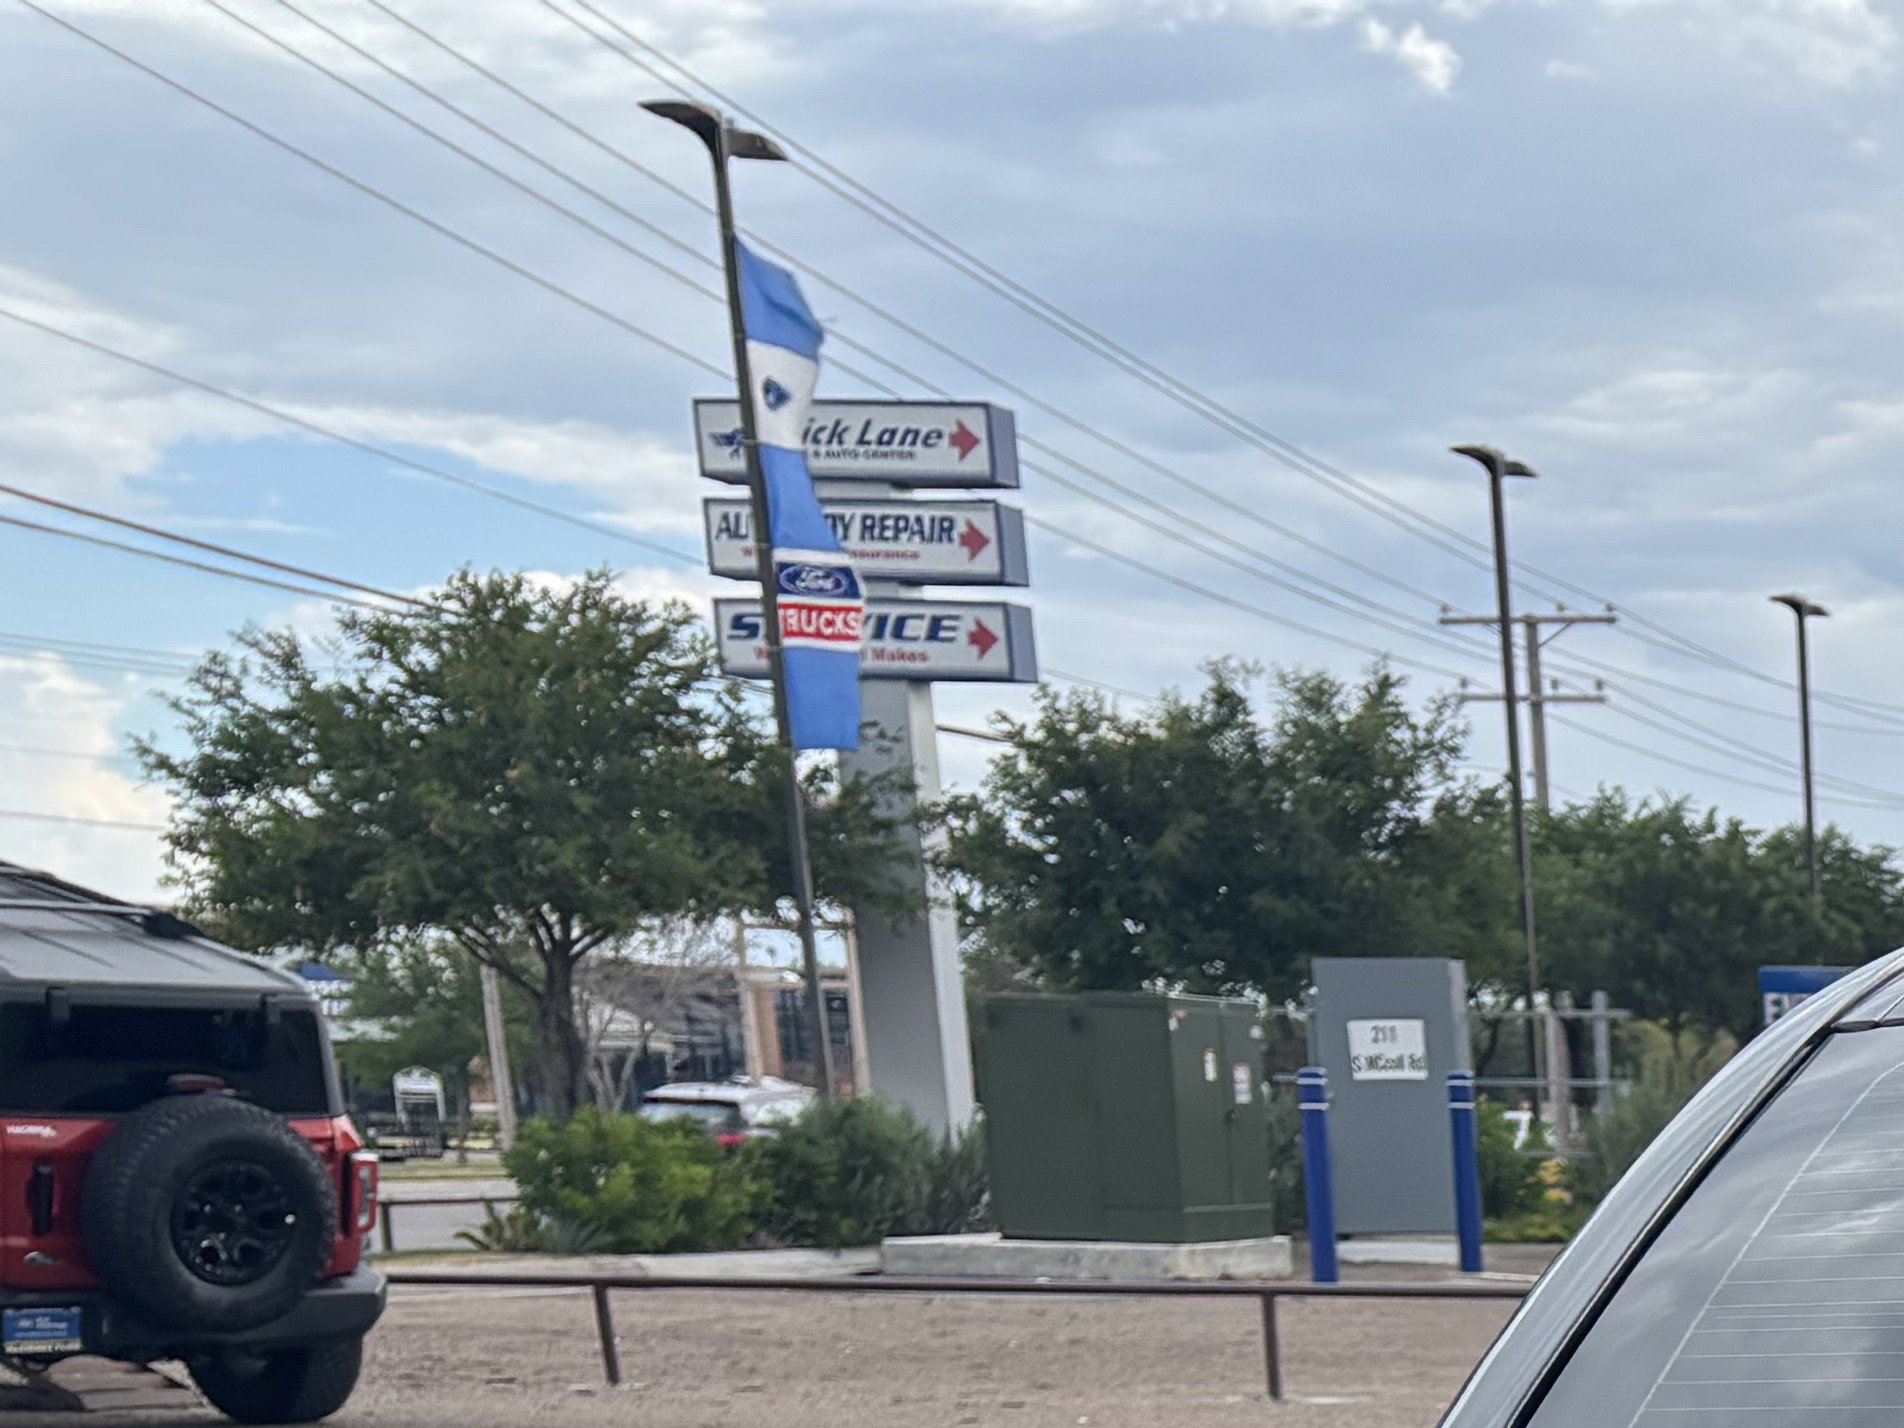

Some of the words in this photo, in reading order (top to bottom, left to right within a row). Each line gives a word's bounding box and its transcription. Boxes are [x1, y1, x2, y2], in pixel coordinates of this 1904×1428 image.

[854, 417, 945, 449] Lane
[859, 512, 956, 545] REPAIR
[873, 649, 930, 663] Makes
